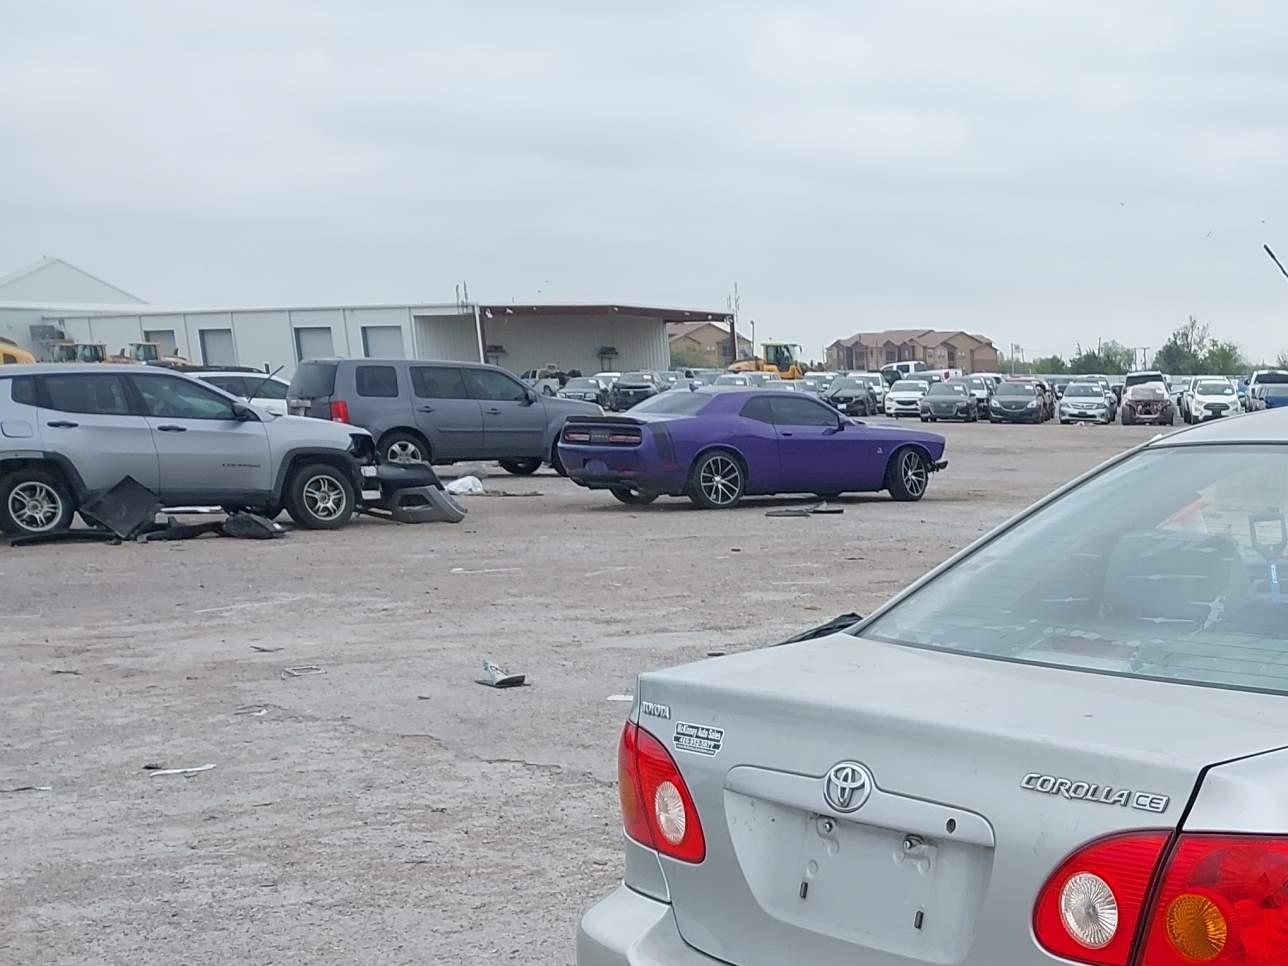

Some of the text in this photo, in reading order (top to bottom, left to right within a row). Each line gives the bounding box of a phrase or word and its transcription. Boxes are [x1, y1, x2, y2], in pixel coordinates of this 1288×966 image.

[641, 701, 671, 719] TOYOTA
[1021, 773, 1167, 812] COROLLA CE
